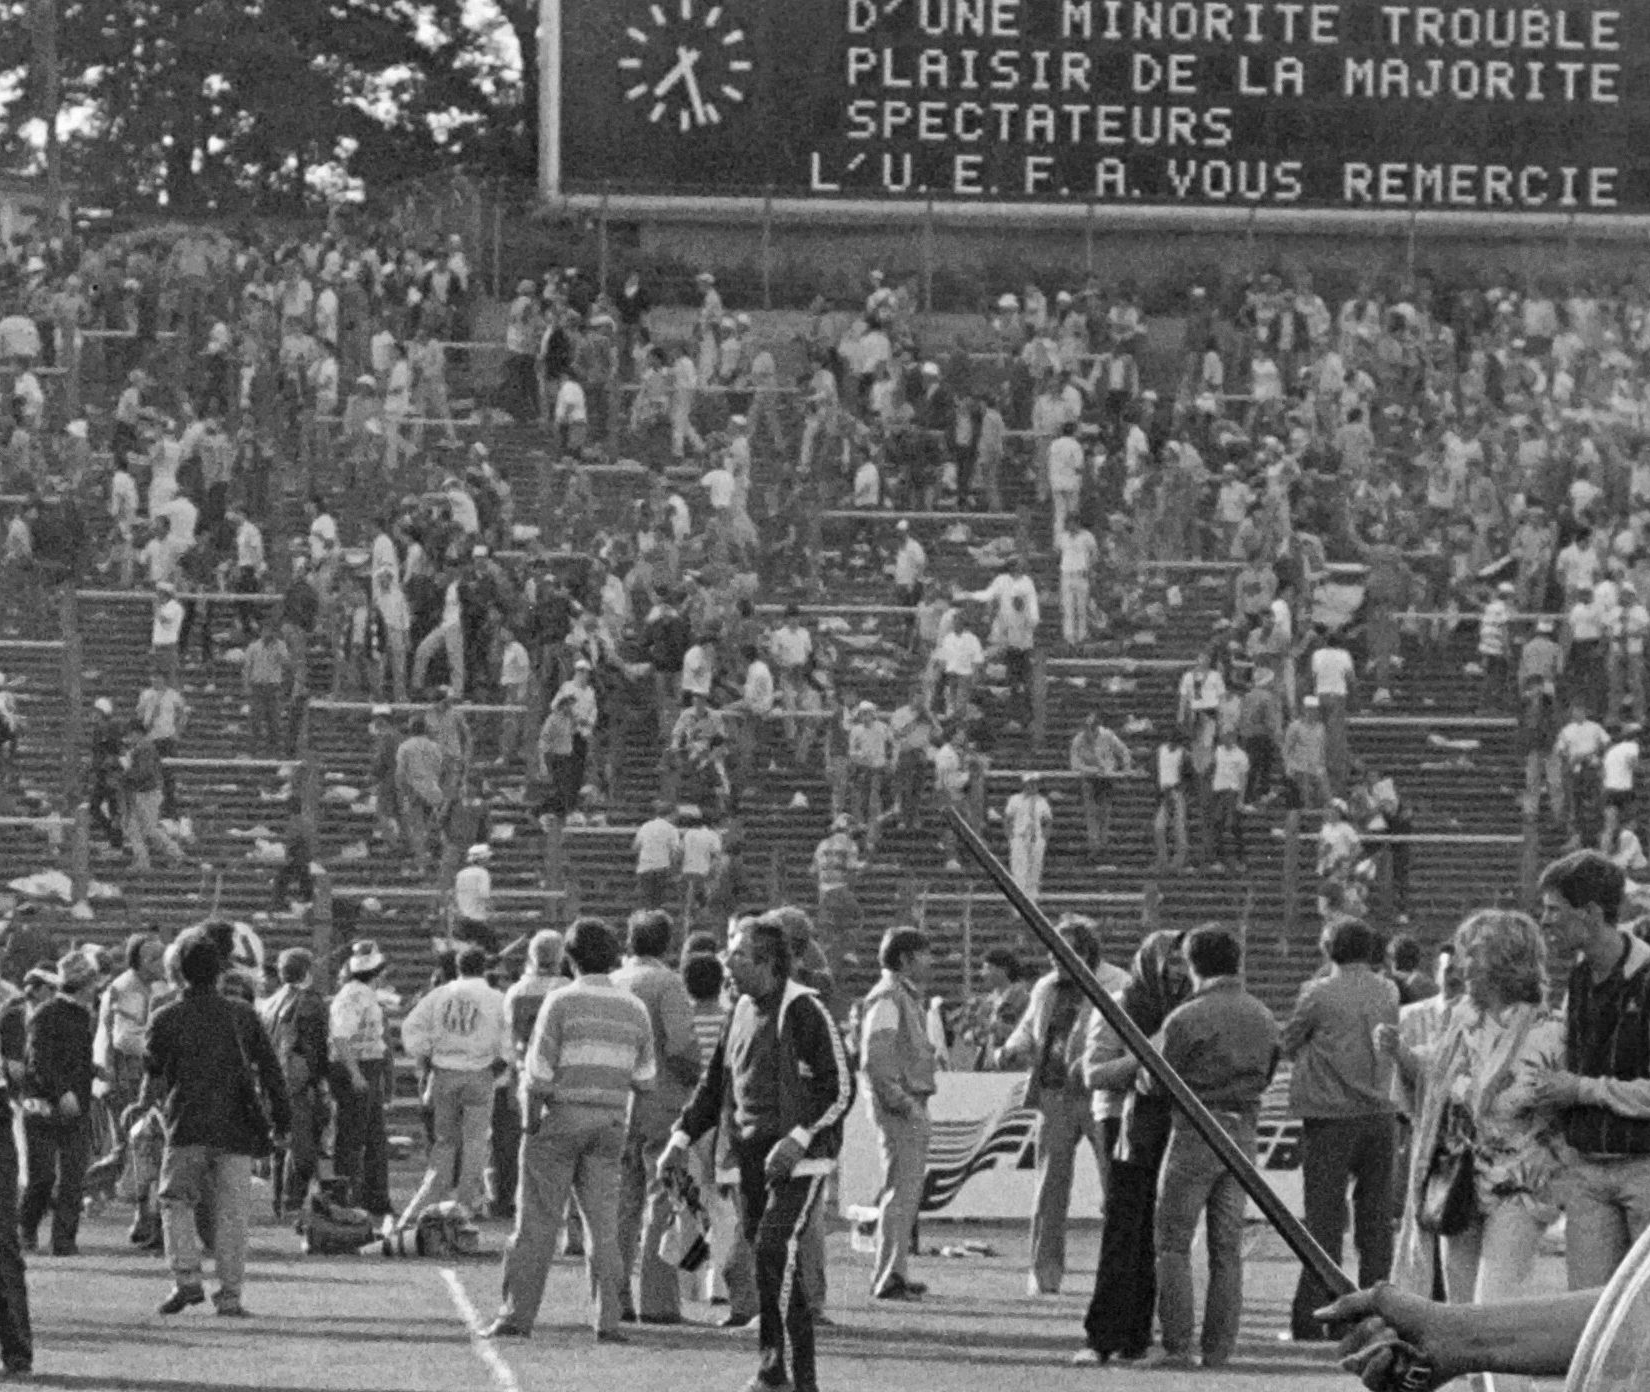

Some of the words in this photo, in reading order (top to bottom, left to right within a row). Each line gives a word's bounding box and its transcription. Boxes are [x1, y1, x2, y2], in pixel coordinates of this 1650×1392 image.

[1063, 0, 1339, 43] MINORITE
[1382, 6, 1620, 50] TROUBLE
[848, 47, 1090, 90] PLAISIR
[1134, 53, 1196, 92] DE
[1240, 56, 1303, 94] LA
[1345, 58, 1620, 102] MAJORITE
[848, 101, 1231, 145] SPECTATEURS
[1345, 163, 1617, 206] REMERCIE
